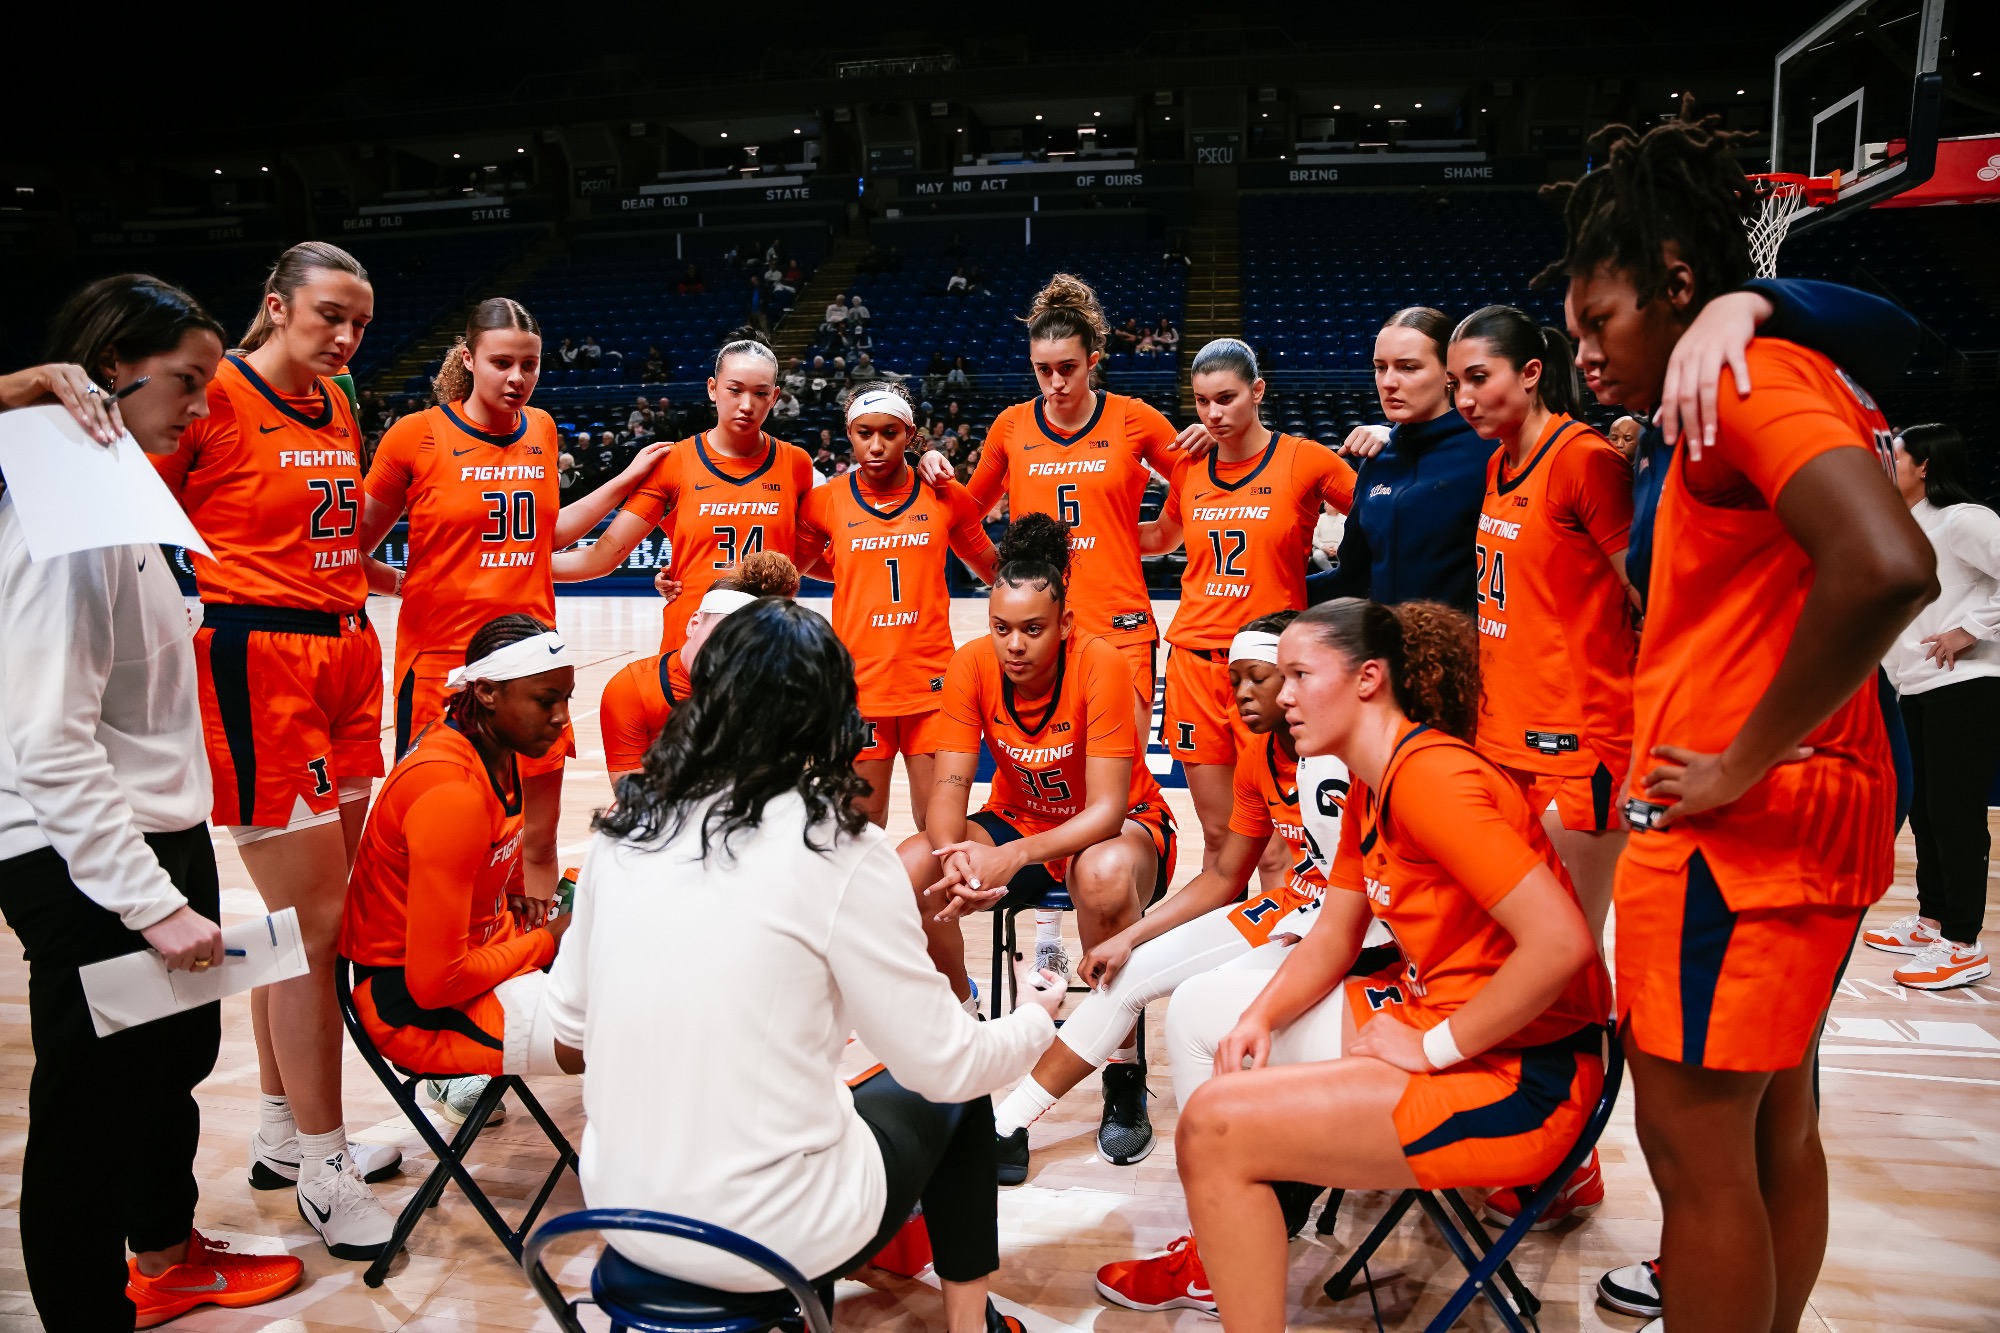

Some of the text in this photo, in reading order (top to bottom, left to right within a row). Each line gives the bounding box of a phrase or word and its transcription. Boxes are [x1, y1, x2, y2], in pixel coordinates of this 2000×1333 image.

[1197, 147, 1233, 164] PSECU
[916, 174, 1143, 195] MAY NO ACT OF OURS
[1289, 166, 1493, 181] BRING SHAME
[621, 187, 810, 210] DEAR OLD STATE
[342, 207, 511, 230] DEAR OLD STATE
[279, 450, 358, 468] FIGHTING
[1028, 459, 1107, 477] FIGHTING
[460, 465, 545, 482] FIGHTING
[307, 478, 358, 540] 25
[481, 490, 537, 542] 30
[699, 502, 780, 517] FIGHTING
[1057, 483, 1081, 528] 6
[1192, 506, 1271, 521] FIGHTING
[1479, 512, 1522, 540] IGHTING
[713, 525, 764, 570] 34
[851, 532, 931, 552] FIGHTING
[1208, 529, 1247, 577] 12
[313, 548, 358, 569] ILLINI
[479, 551, 536, 568] ILLINI
[885, 558, 901, 604] 1
[1476, 542, 1507, 611] 24
[1204, 582, 1251, 598] ILLINI
[871, 611, 919, 628] ILLINI
[1477, 614, 1508, 639] LLINI
[1177, 721, 1196, 750] I
[997, 738, 1075, 764] FIGHTING
[307, 755, 332, 797] I
[1012, 768, 1072, 802] 35
[1026, 799, 1077, 815] ILLINI
[490, 828, 524, 868] FIGHT
